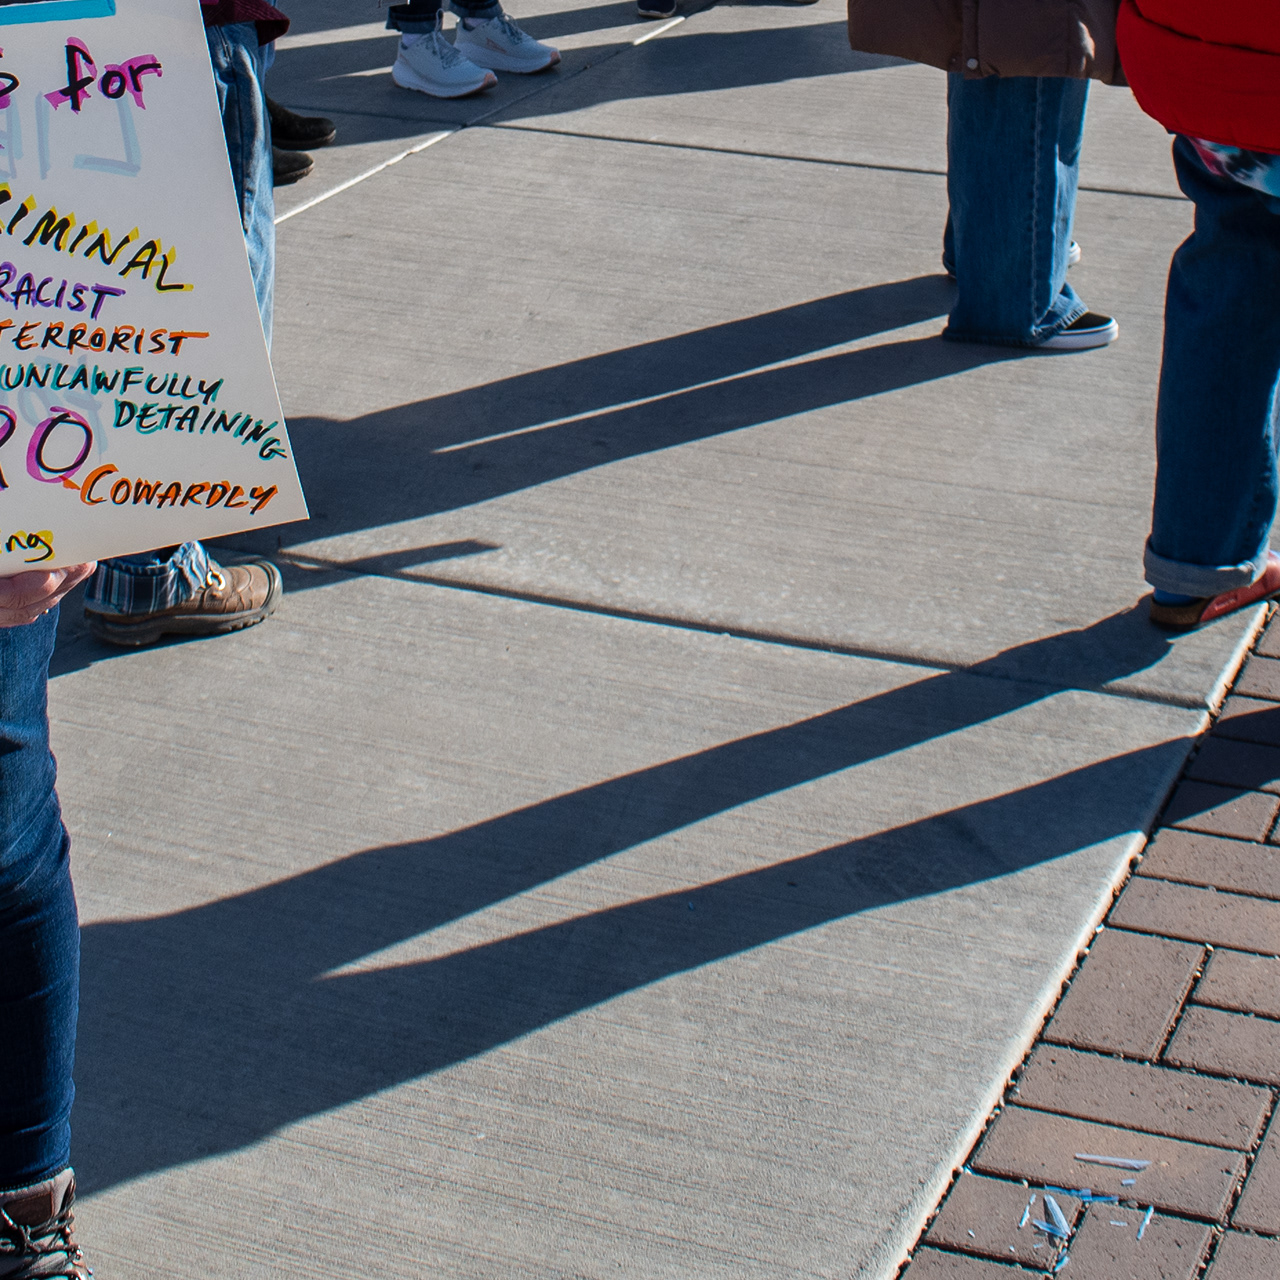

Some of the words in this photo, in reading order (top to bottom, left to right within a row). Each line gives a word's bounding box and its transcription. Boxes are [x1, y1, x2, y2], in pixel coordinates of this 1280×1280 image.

[44, 36, 163, 115] for
[113, 399, 289, 462] DETAINING
[80, 464, 279, 516] COWARDLY
